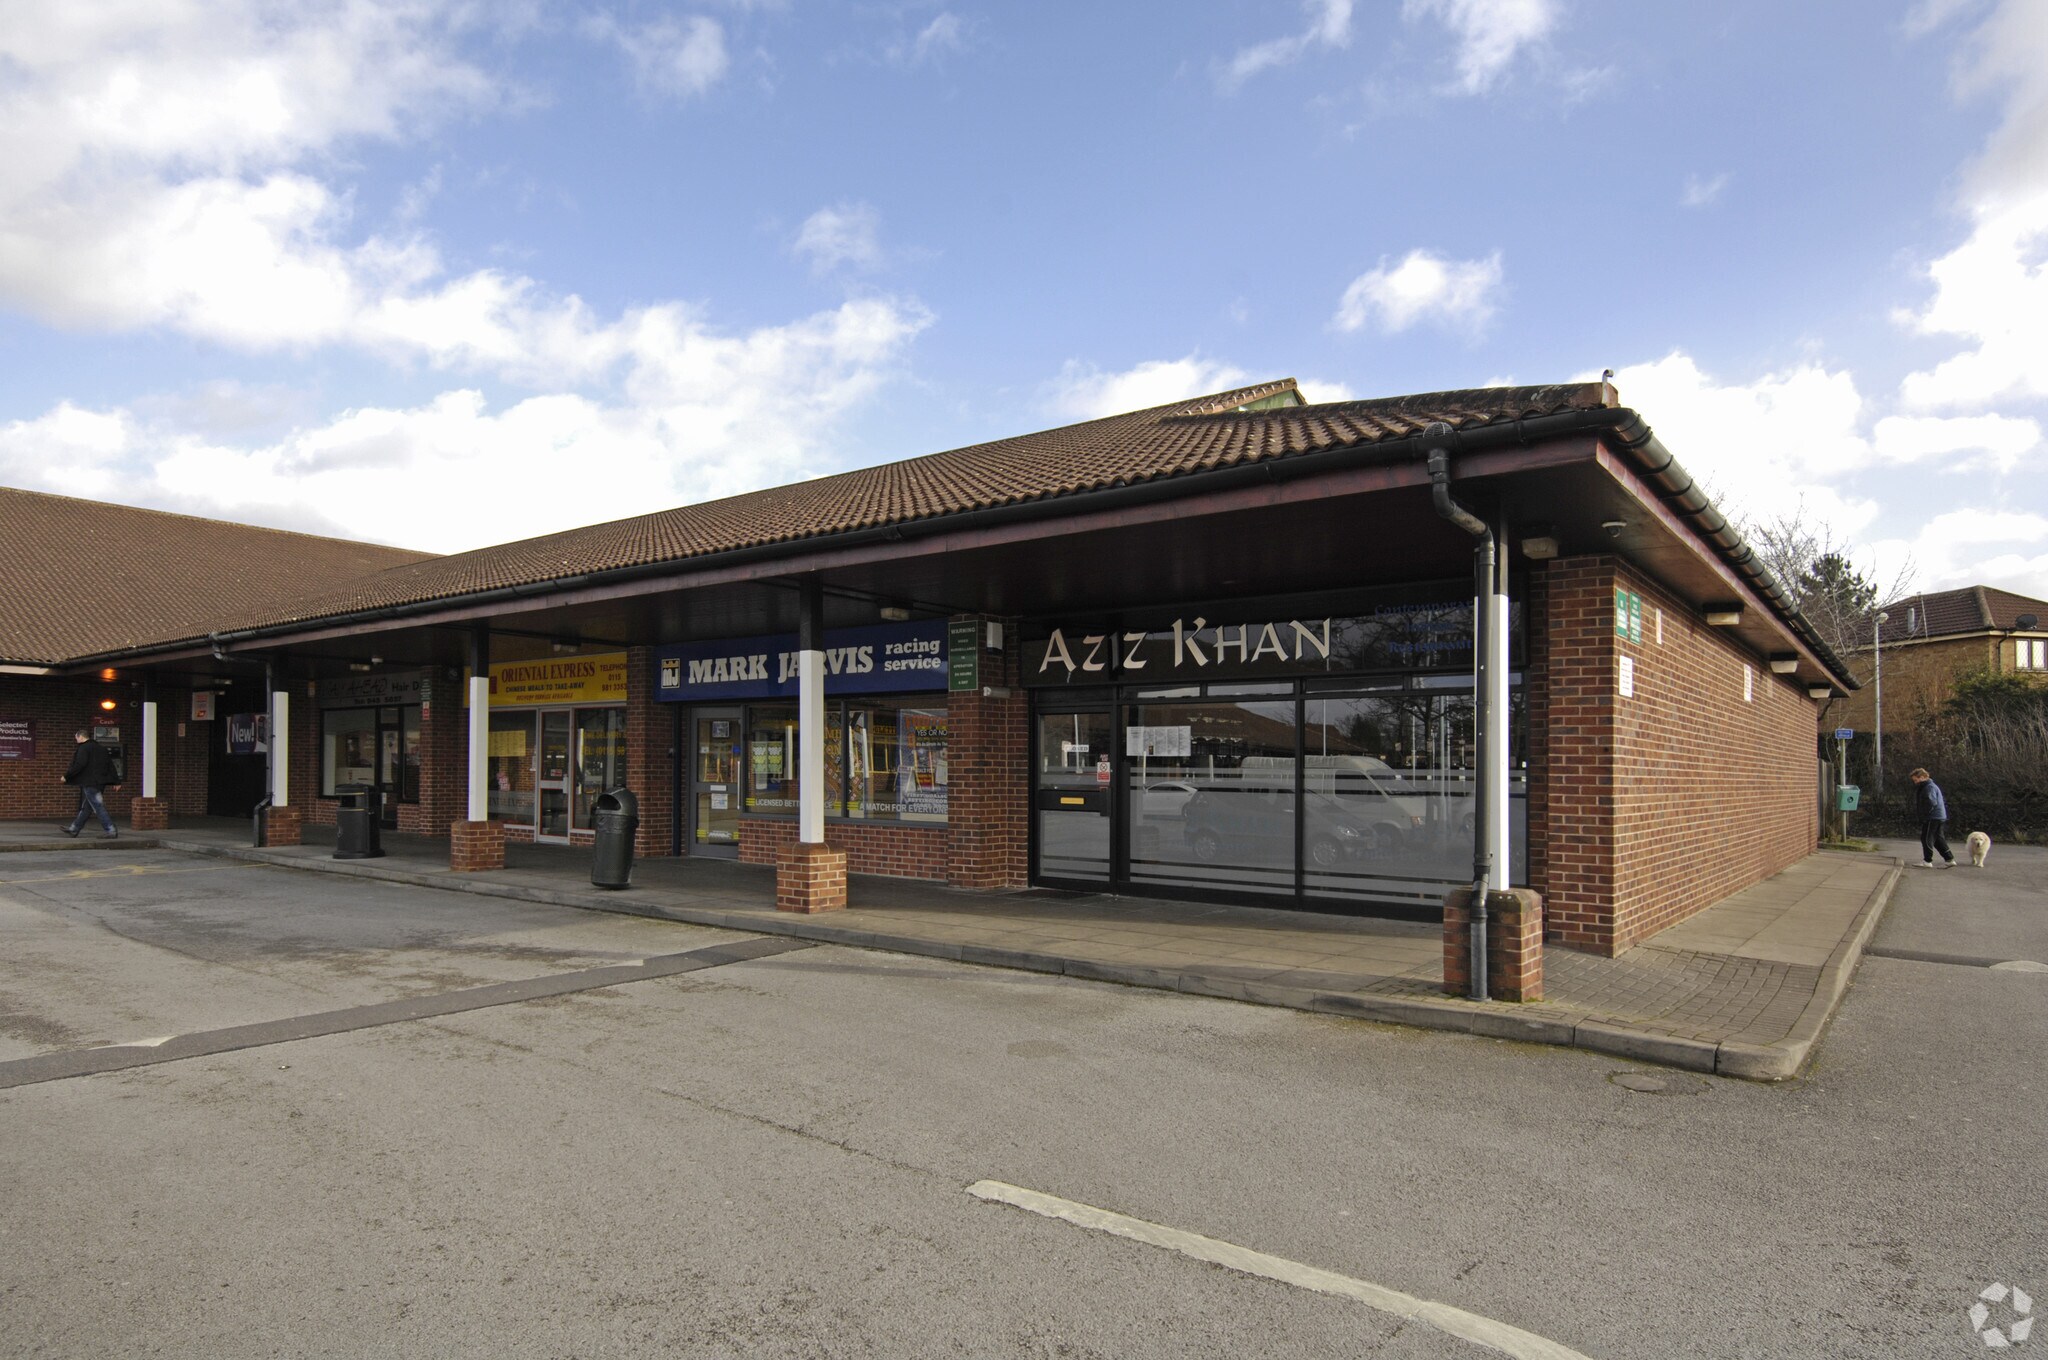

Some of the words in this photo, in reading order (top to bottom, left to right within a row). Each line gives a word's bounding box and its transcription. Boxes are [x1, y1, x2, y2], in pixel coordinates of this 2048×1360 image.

[1375, 600, 1473, 616] Contemporar
[885, 638, 940, 655] racing
[1171, 616, 1331, 668] KHAN
[688, 655, 768, 684] MARK
[884, 655, 941, 671] service
[501, 667, 548, 683] ORIENTAL
[550, 661, 596, 680] EXPRESS
[608, 673, 621, 681] 0115
[391, 681, 409, 692] Hair
[555, 682, 585, 690] TAKE-AWAY
[231, 722, 255, 743] New!
[755, 799, 783, 808] LICENSED
[784, 799, 800, 808] BETT
[866, 803, 891, 811] MATCH
[891, 803, 907, 812] FOR
[908, 804, 948, 814] EVERYONE
